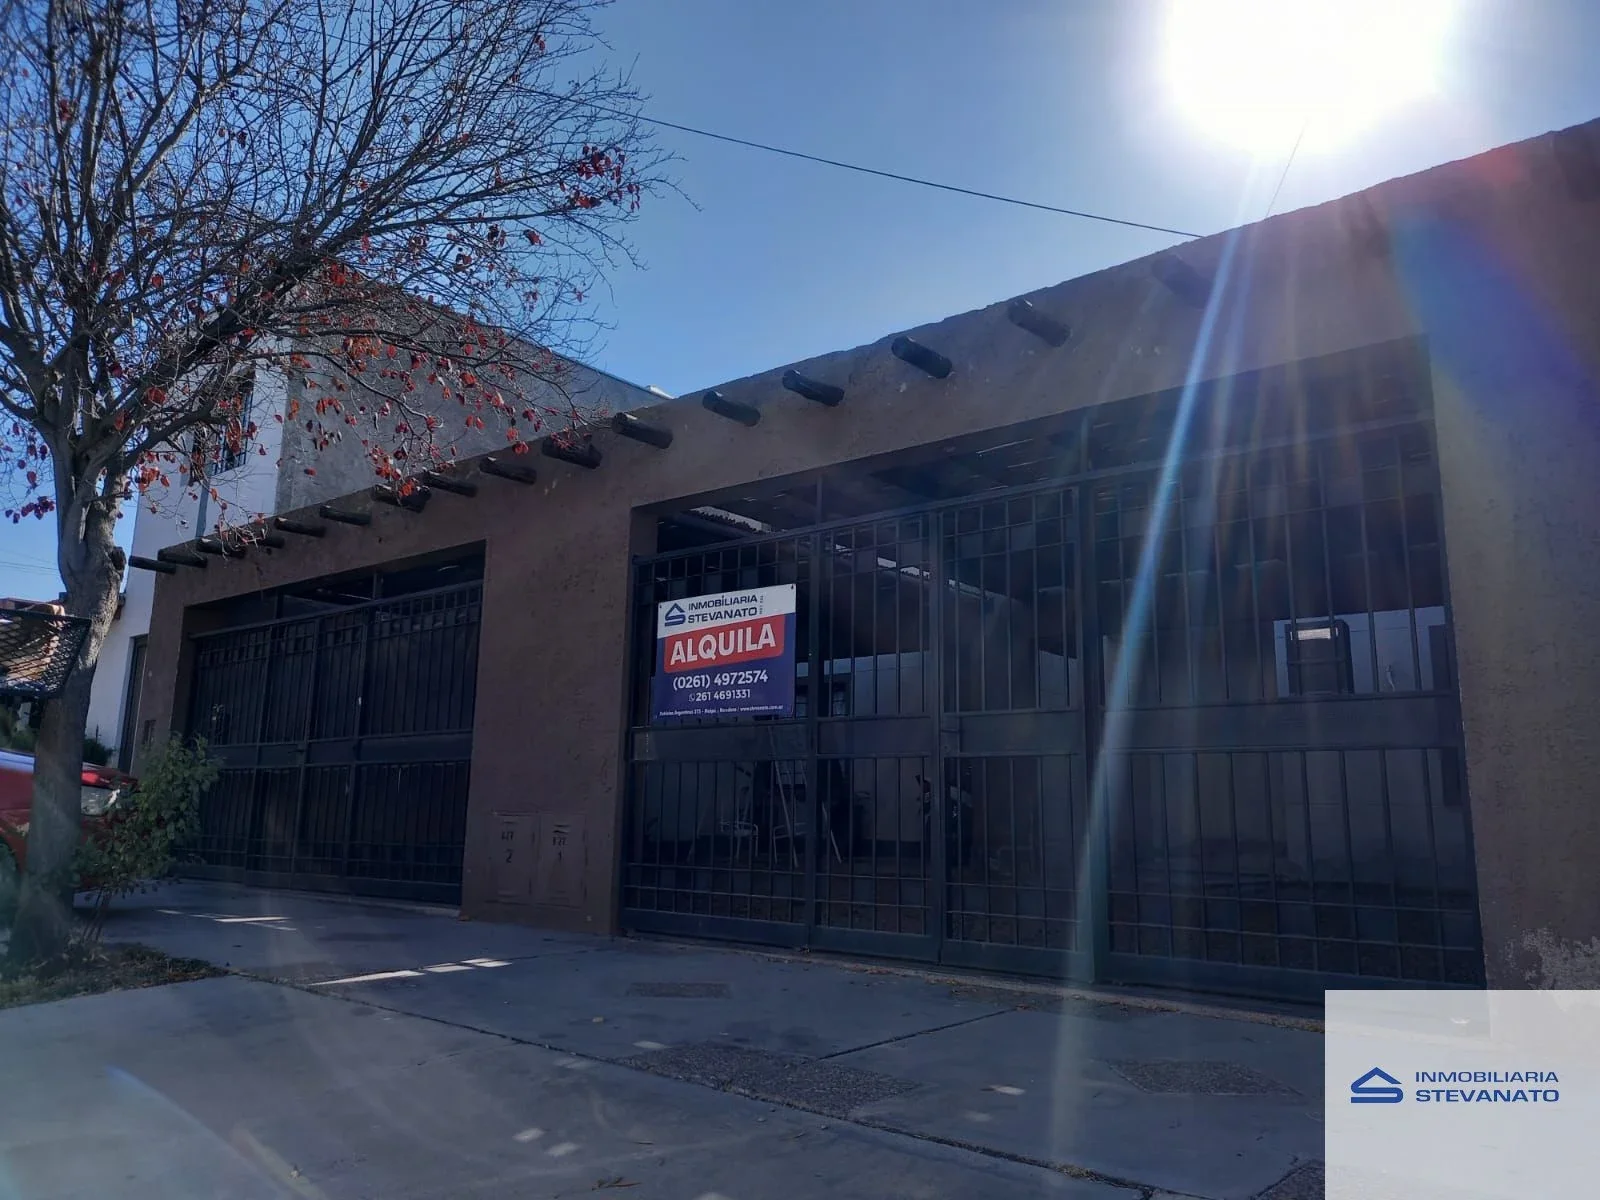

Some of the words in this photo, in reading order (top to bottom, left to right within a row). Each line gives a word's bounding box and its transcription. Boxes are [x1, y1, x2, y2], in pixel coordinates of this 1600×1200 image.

[688, 594, 758, 611] INMOBILIARIA
[687, 606, 758, 624] STEVANATO
[670, 623, 776, 666] ALQUILA
[672, 674, 711, 691] (0261)
[713, 669, 768, 687] 4972574
[695, 691, 711, 702] 261
[713, 688, 751, 701] 4691331
